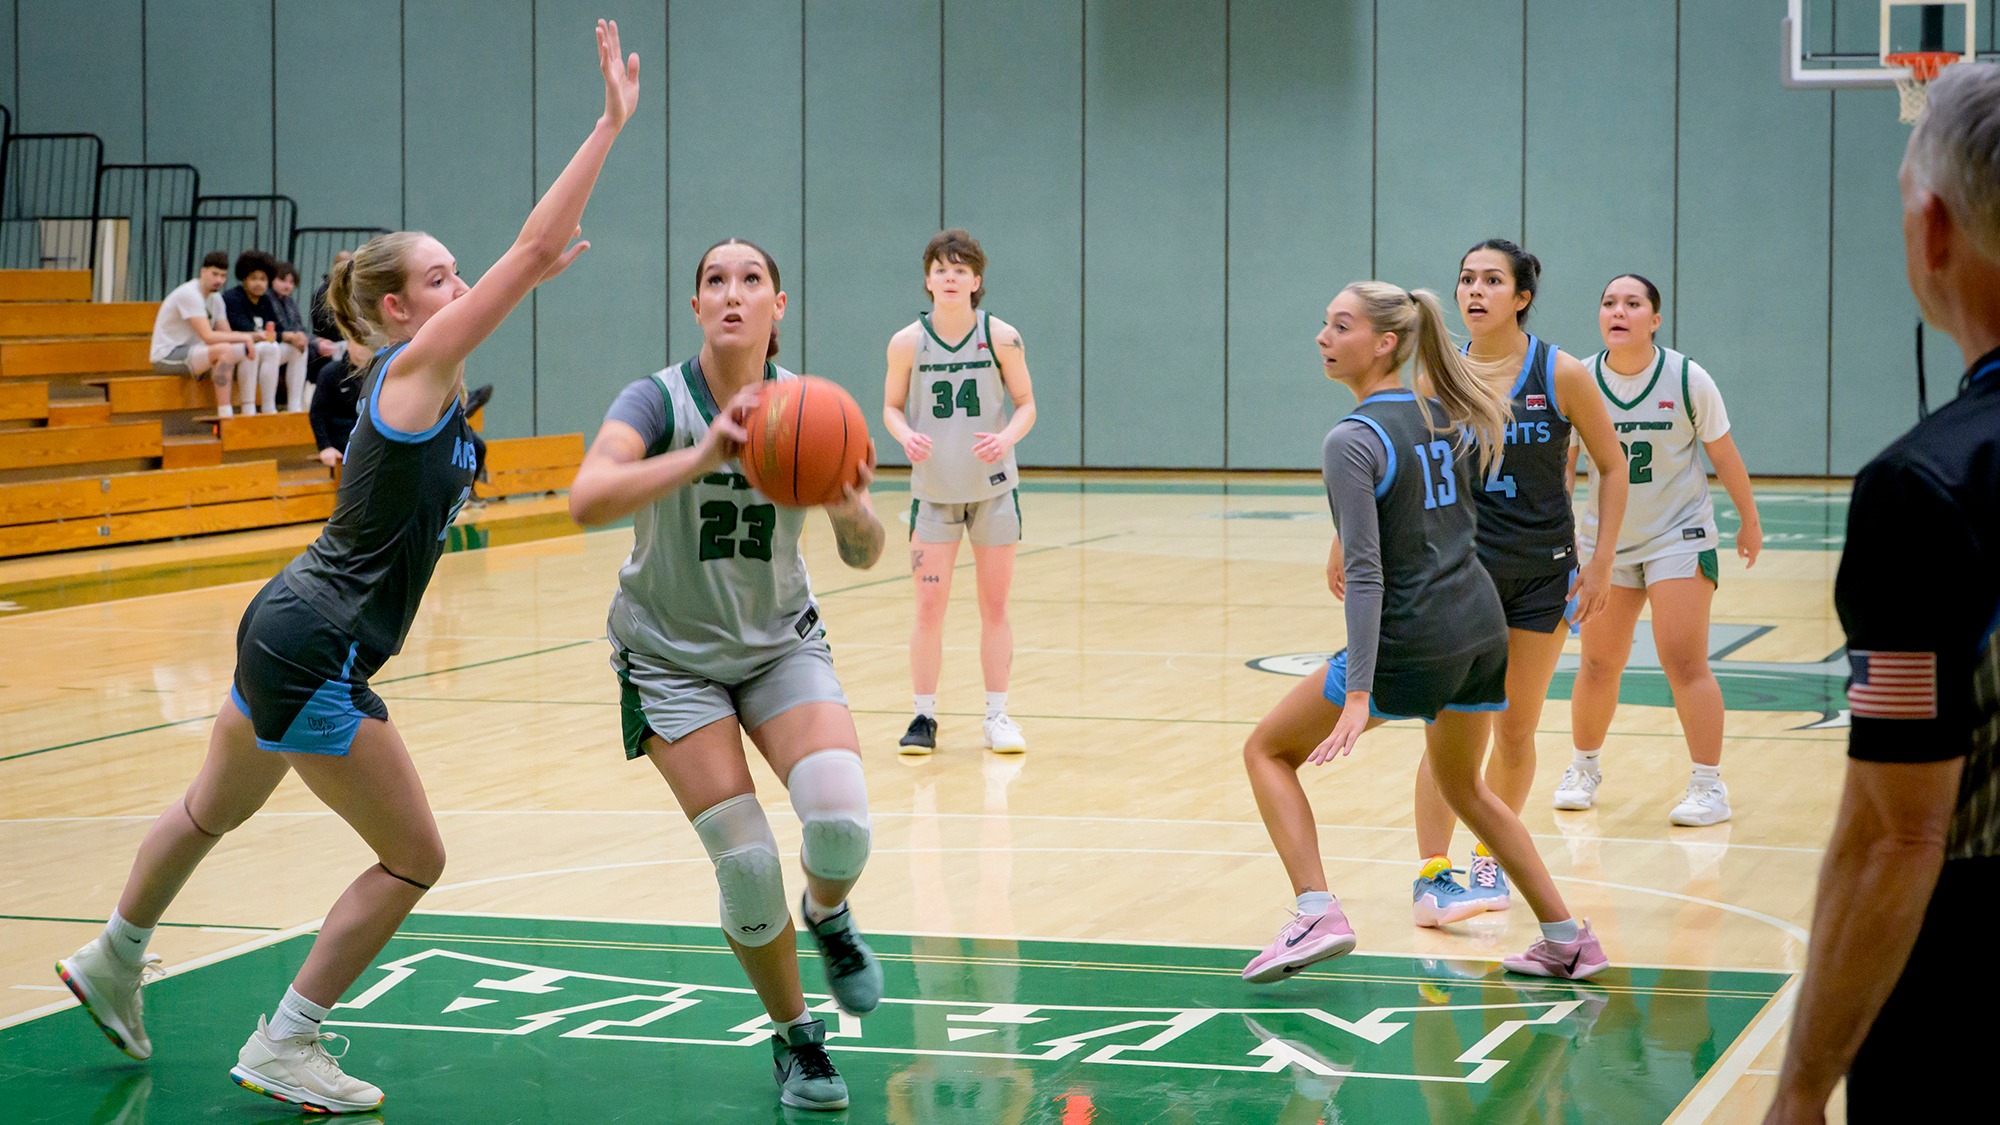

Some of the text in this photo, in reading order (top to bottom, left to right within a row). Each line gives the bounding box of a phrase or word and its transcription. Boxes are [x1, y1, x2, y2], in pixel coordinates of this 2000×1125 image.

[931, 378, 981, 419] 34
[1414, 439, 1458, 511] 13
[1484, 454, 1518, 499] 4
[699, 500, 777, 563] 23
